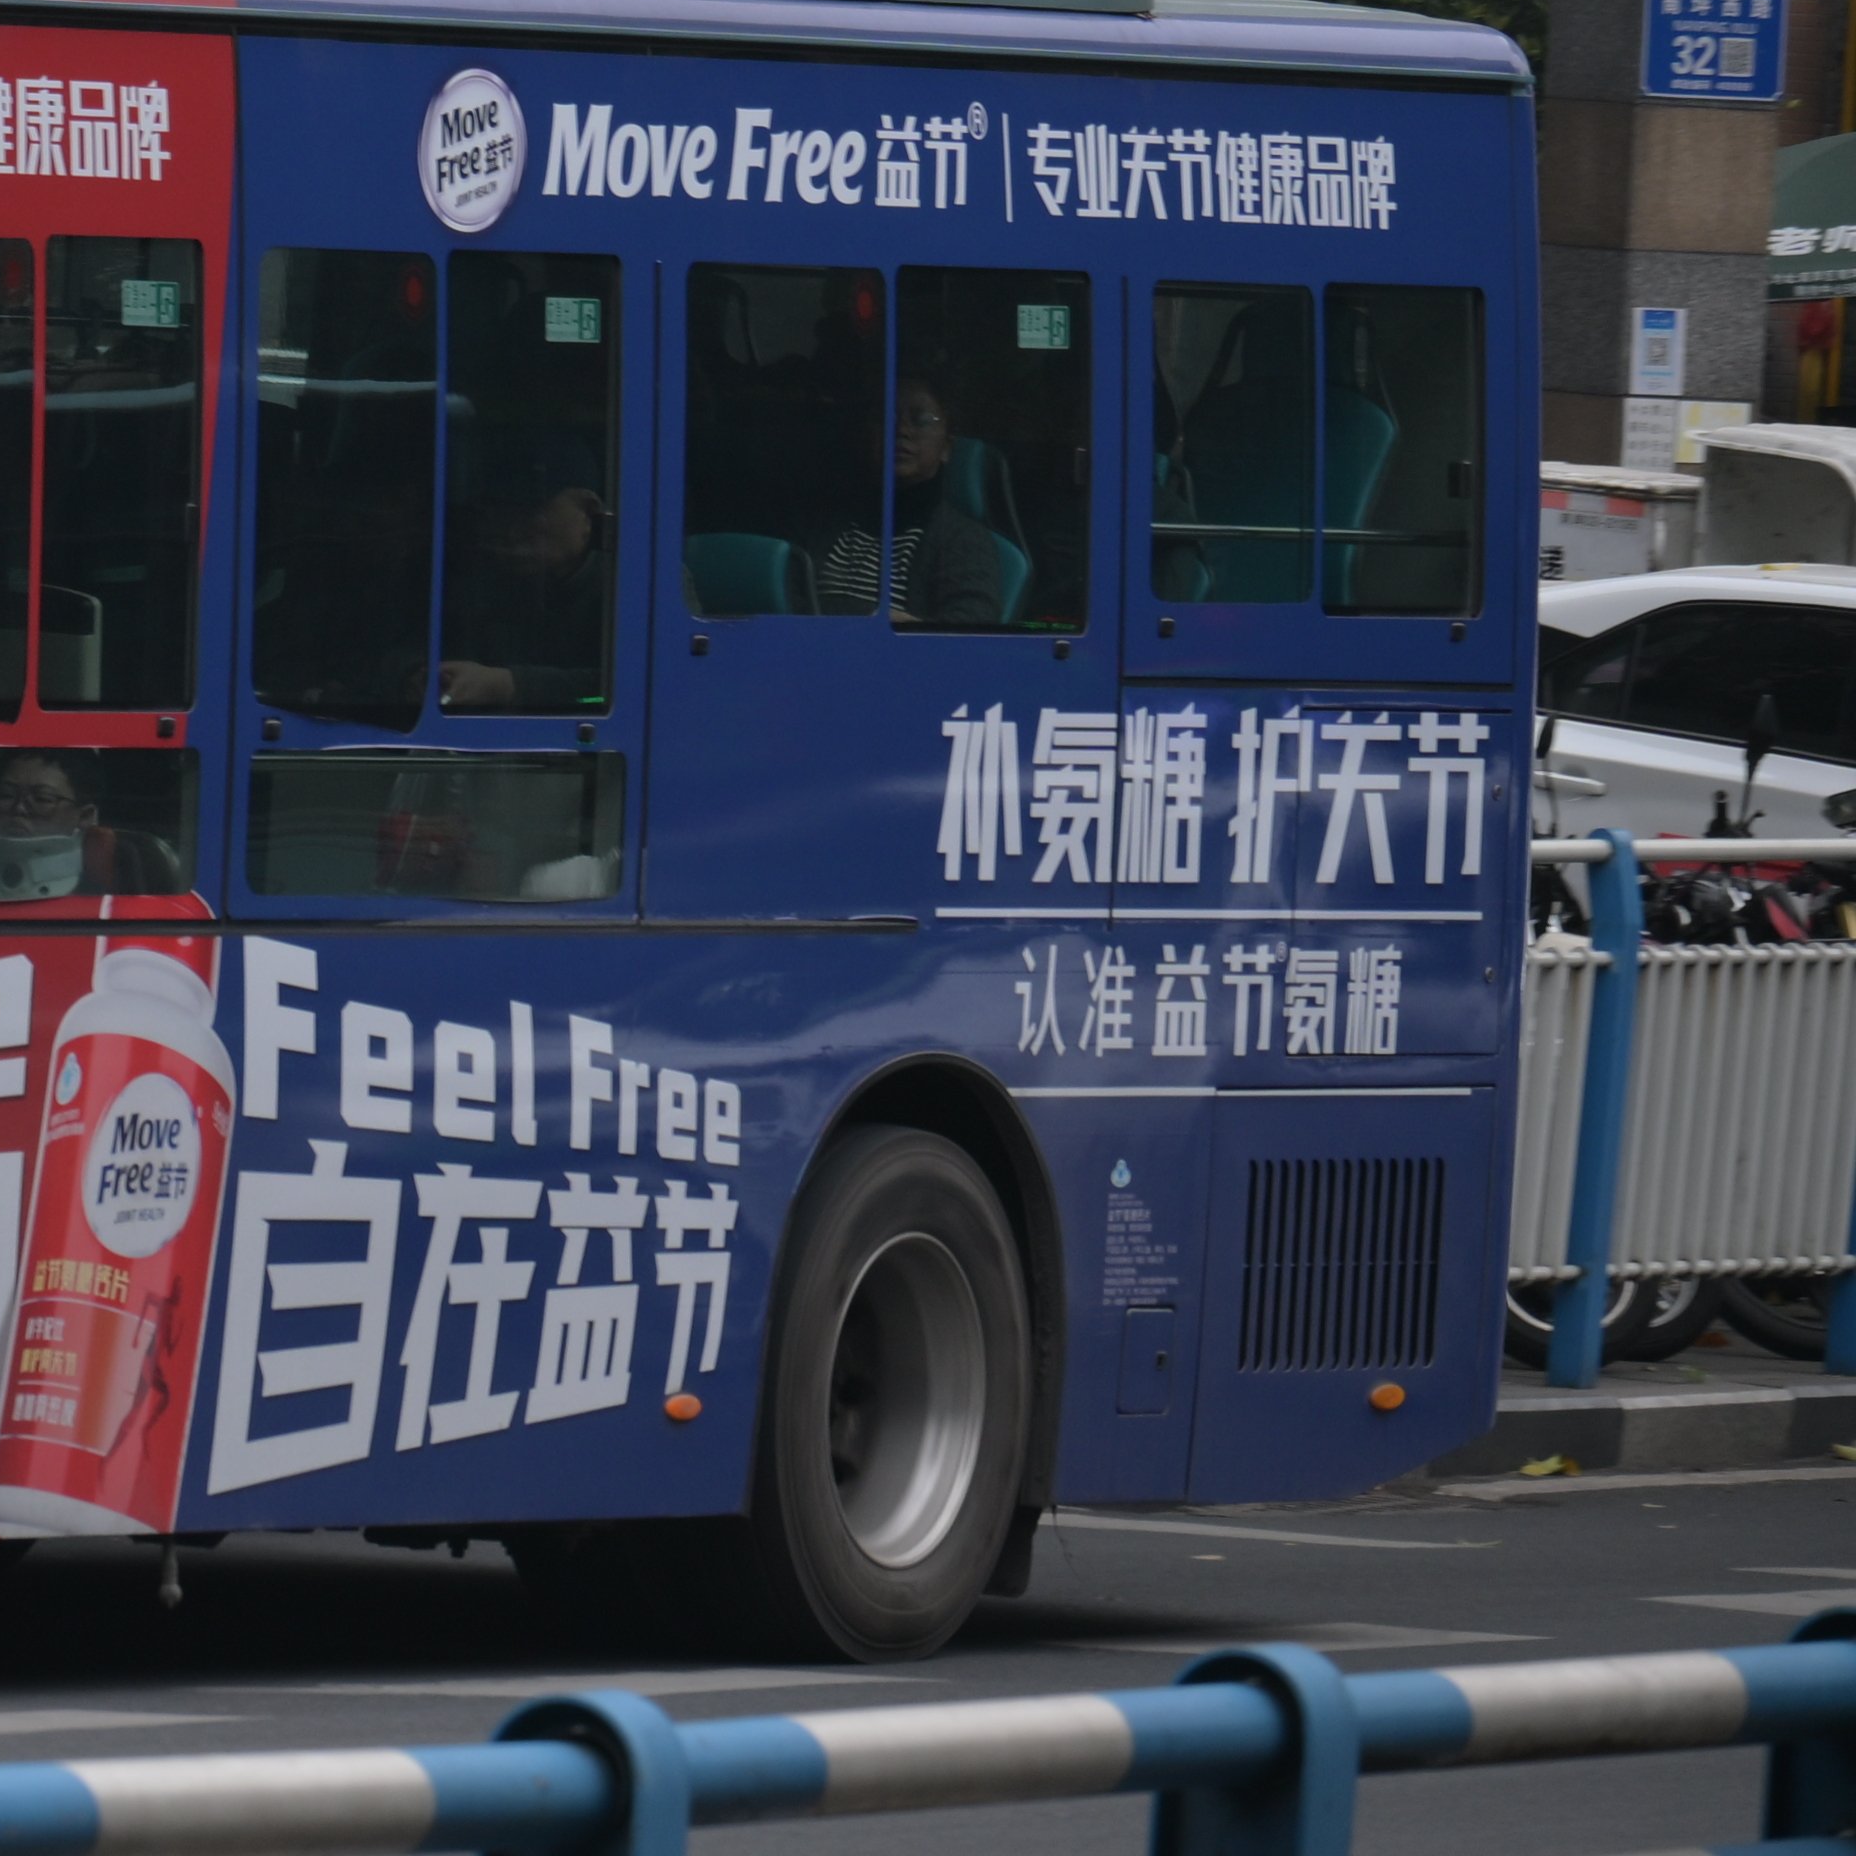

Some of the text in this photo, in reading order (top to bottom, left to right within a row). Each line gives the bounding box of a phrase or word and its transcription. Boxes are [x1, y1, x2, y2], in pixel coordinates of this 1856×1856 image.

[1670, 34, 1717, 76] 32
[440, 100, 499, 148] Move
[436, 146, 481, 193] Free
[542, 103, 715, 199] Move
[726, 107, 867, 205] Free
[1027, 122, 1397, 230] 专业关节健康品牌
[936, 702, 1490, 884] 补氨糖 护关节
[242, 935, 741, 1166] Feel Free
[111, 1113, 181, 1154] Move
[96, 1162, 154, 1205] Free
[207, 1137, 741, 1496] 自在益节
